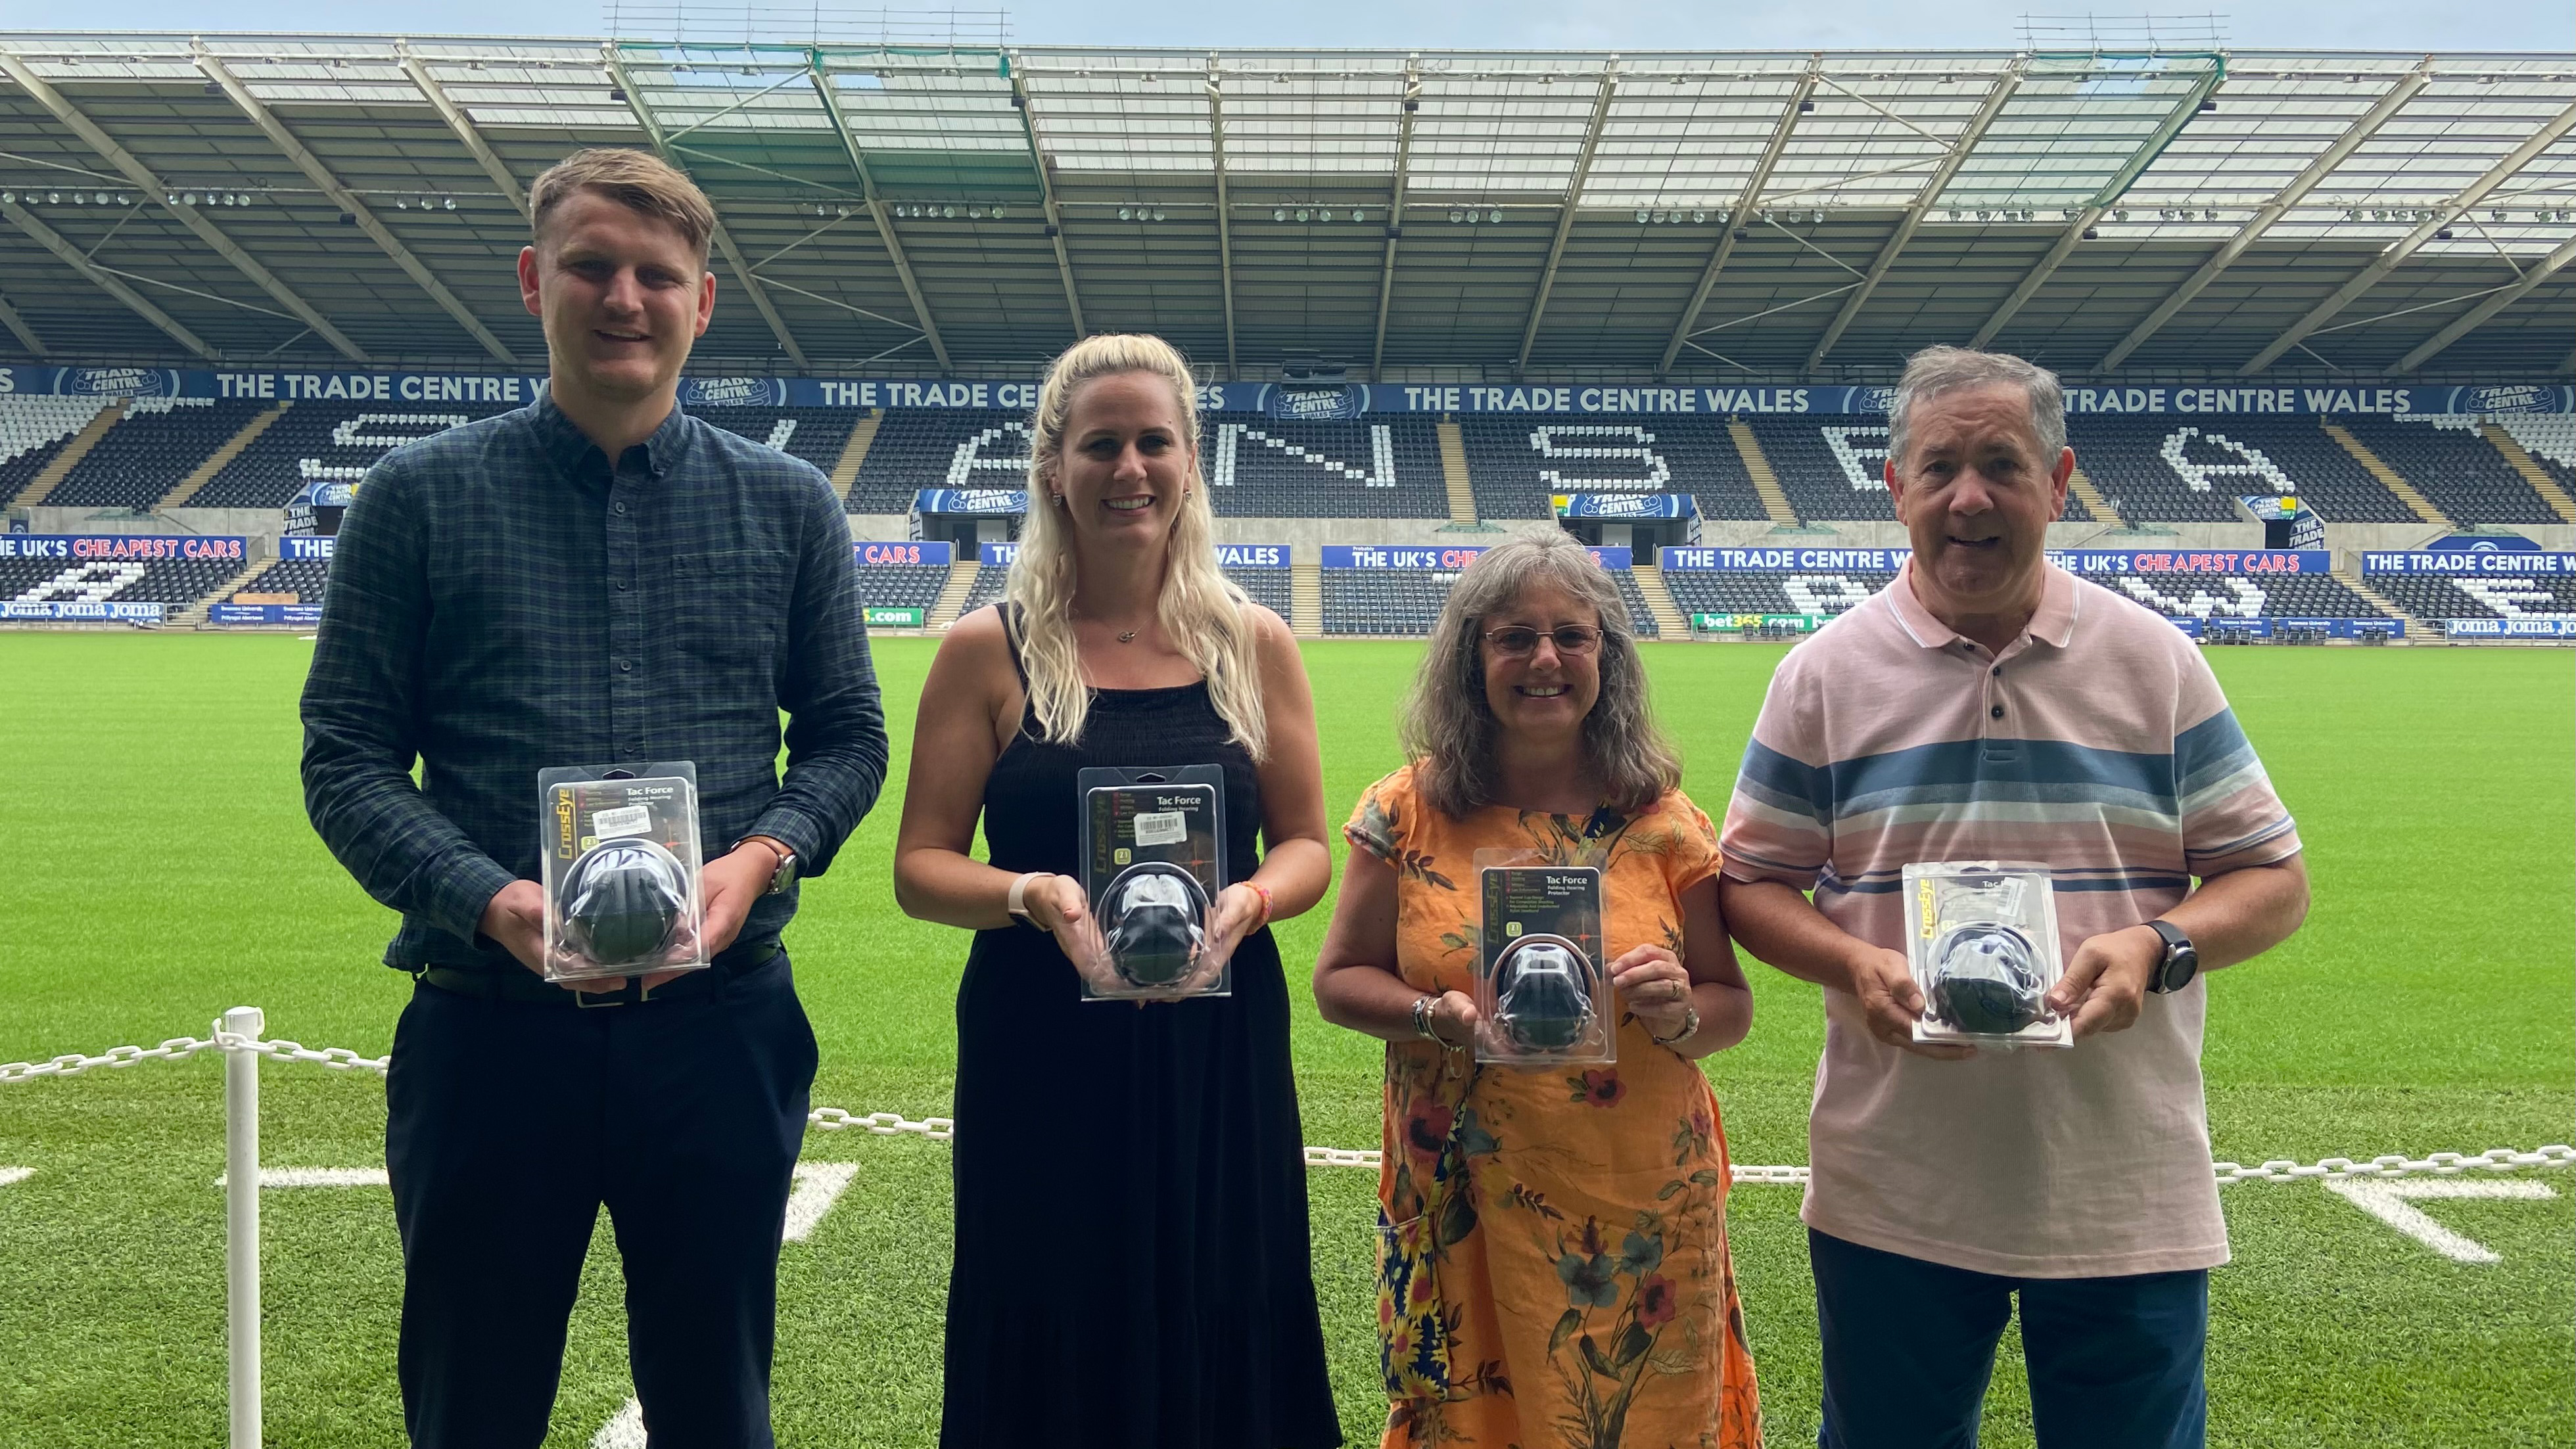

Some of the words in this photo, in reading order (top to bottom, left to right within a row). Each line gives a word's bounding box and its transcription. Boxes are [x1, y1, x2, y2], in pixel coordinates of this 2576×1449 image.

[92, 376, 143, 391] CENTRE
[217, 373, 274, 398] THE
[284, 375, 390, 400] TRADE
[400, 376, 520, 401] CENTRE
[705, 385, 752, 401] CENTRE
[820, 382, 876, 406] THE
[886, 383, 988, 407] TRADE
[1286, 390, 1342, 402] TRADE
[1405, 387, 1460, 410] THE
[1469, 388, 1570, 411] TRADE
[1580, 388, 1696, 412] CENTRE
[1704, 389, 1809, 413] WALES
[2479, 385, 2540, 399] TRADE
[1292, 398, 1339, 413] CENTRE
[2063, 389, 2165, 412] TRADE
[2175, 388, 2294, 412] CENTRE
[2304, 389, 2411, 413] WALES
[2485, 394, 2536, 409] CENTRE
[967, 495, 1013, 511] CENTRE
[1599, 499, 1645, 515] CENTRE
[291, 506, 311, 517] THE
[284, 516, 318, 531] TRADE
[2295, 518, 2317, 534] THE
[2289, 528, 2325, 547] TRADE
[22, 539, 67, 557] UK'S
[73, 538, 177, 558] CHEAPEST
[184, 539, 241, 558] CARS
[291, 539, 334, 557] THE
[865, 545, 920, 564] CARS
[992, 546, 1019, 563] TH
[1214, 547, 1279, 565] WALES
[1352, 552, 1388, 567] THE
[1393, 552, 1436, 567] UK'S
[1674, 550, 1714, 567] THE
[1721, 550, 1794, 567] TRADE
[1800, 551, 1884, 568] CENTRE
[2084, 555, 2128, 571] UK'S
[2134, 554, 2237, 572] CHEAPEST
[2243, 554, 2300, 572] CARS
[2367, 555, 2404, 570] THE
[2410, 555, 2476, 571] TRADE
[2482, 555, 2557, 571] CENTRE
[55, 603, 107, 618] Joma
[110, 604, 161, 619] Joma
[2449, 620, 2501, 634] Joma
[2504, 620, 2555, 635] Joma
[2558, 620, 2576, 635] Jo
[645, 787, 674, 795] Force
[1157, 796, 1173, 805] Tac
[1174, 796, 1201, 805] Force
[556, 788, 573, 860] CrossEye
[1546, 876, 1560, 884] Tac
[1562, 876, 1588, 884] Force
[1918, 879, 1934, 939] CrossEye
